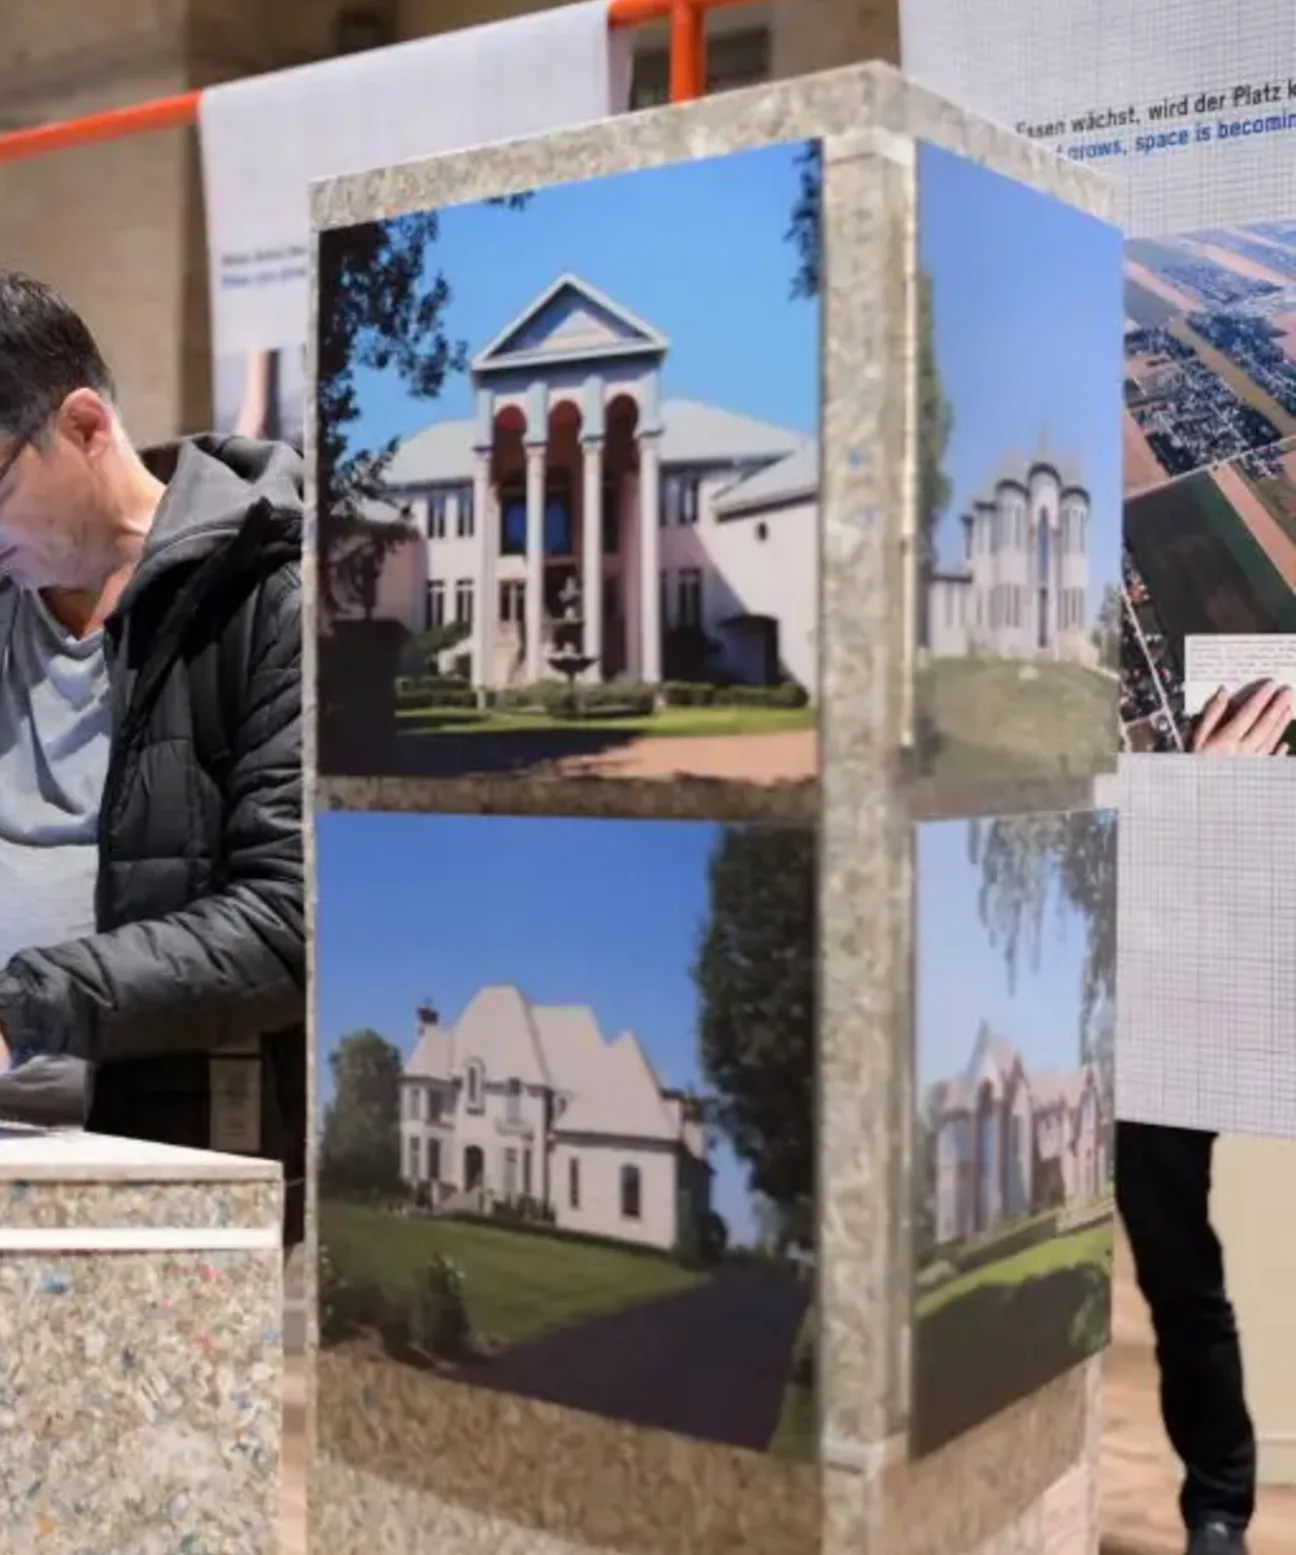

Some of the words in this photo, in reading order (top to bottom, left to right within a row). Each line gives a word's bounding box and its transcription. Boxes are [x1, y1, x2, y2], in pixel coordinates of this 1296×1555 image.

[1148, 95, 1188, 121] wird
[1194, 93, 1225, 114] der
[1233, 84, 1281, 109] Platz
[1135, 128, 1189, 155] space
[1195, 122, 1210, 142] is
